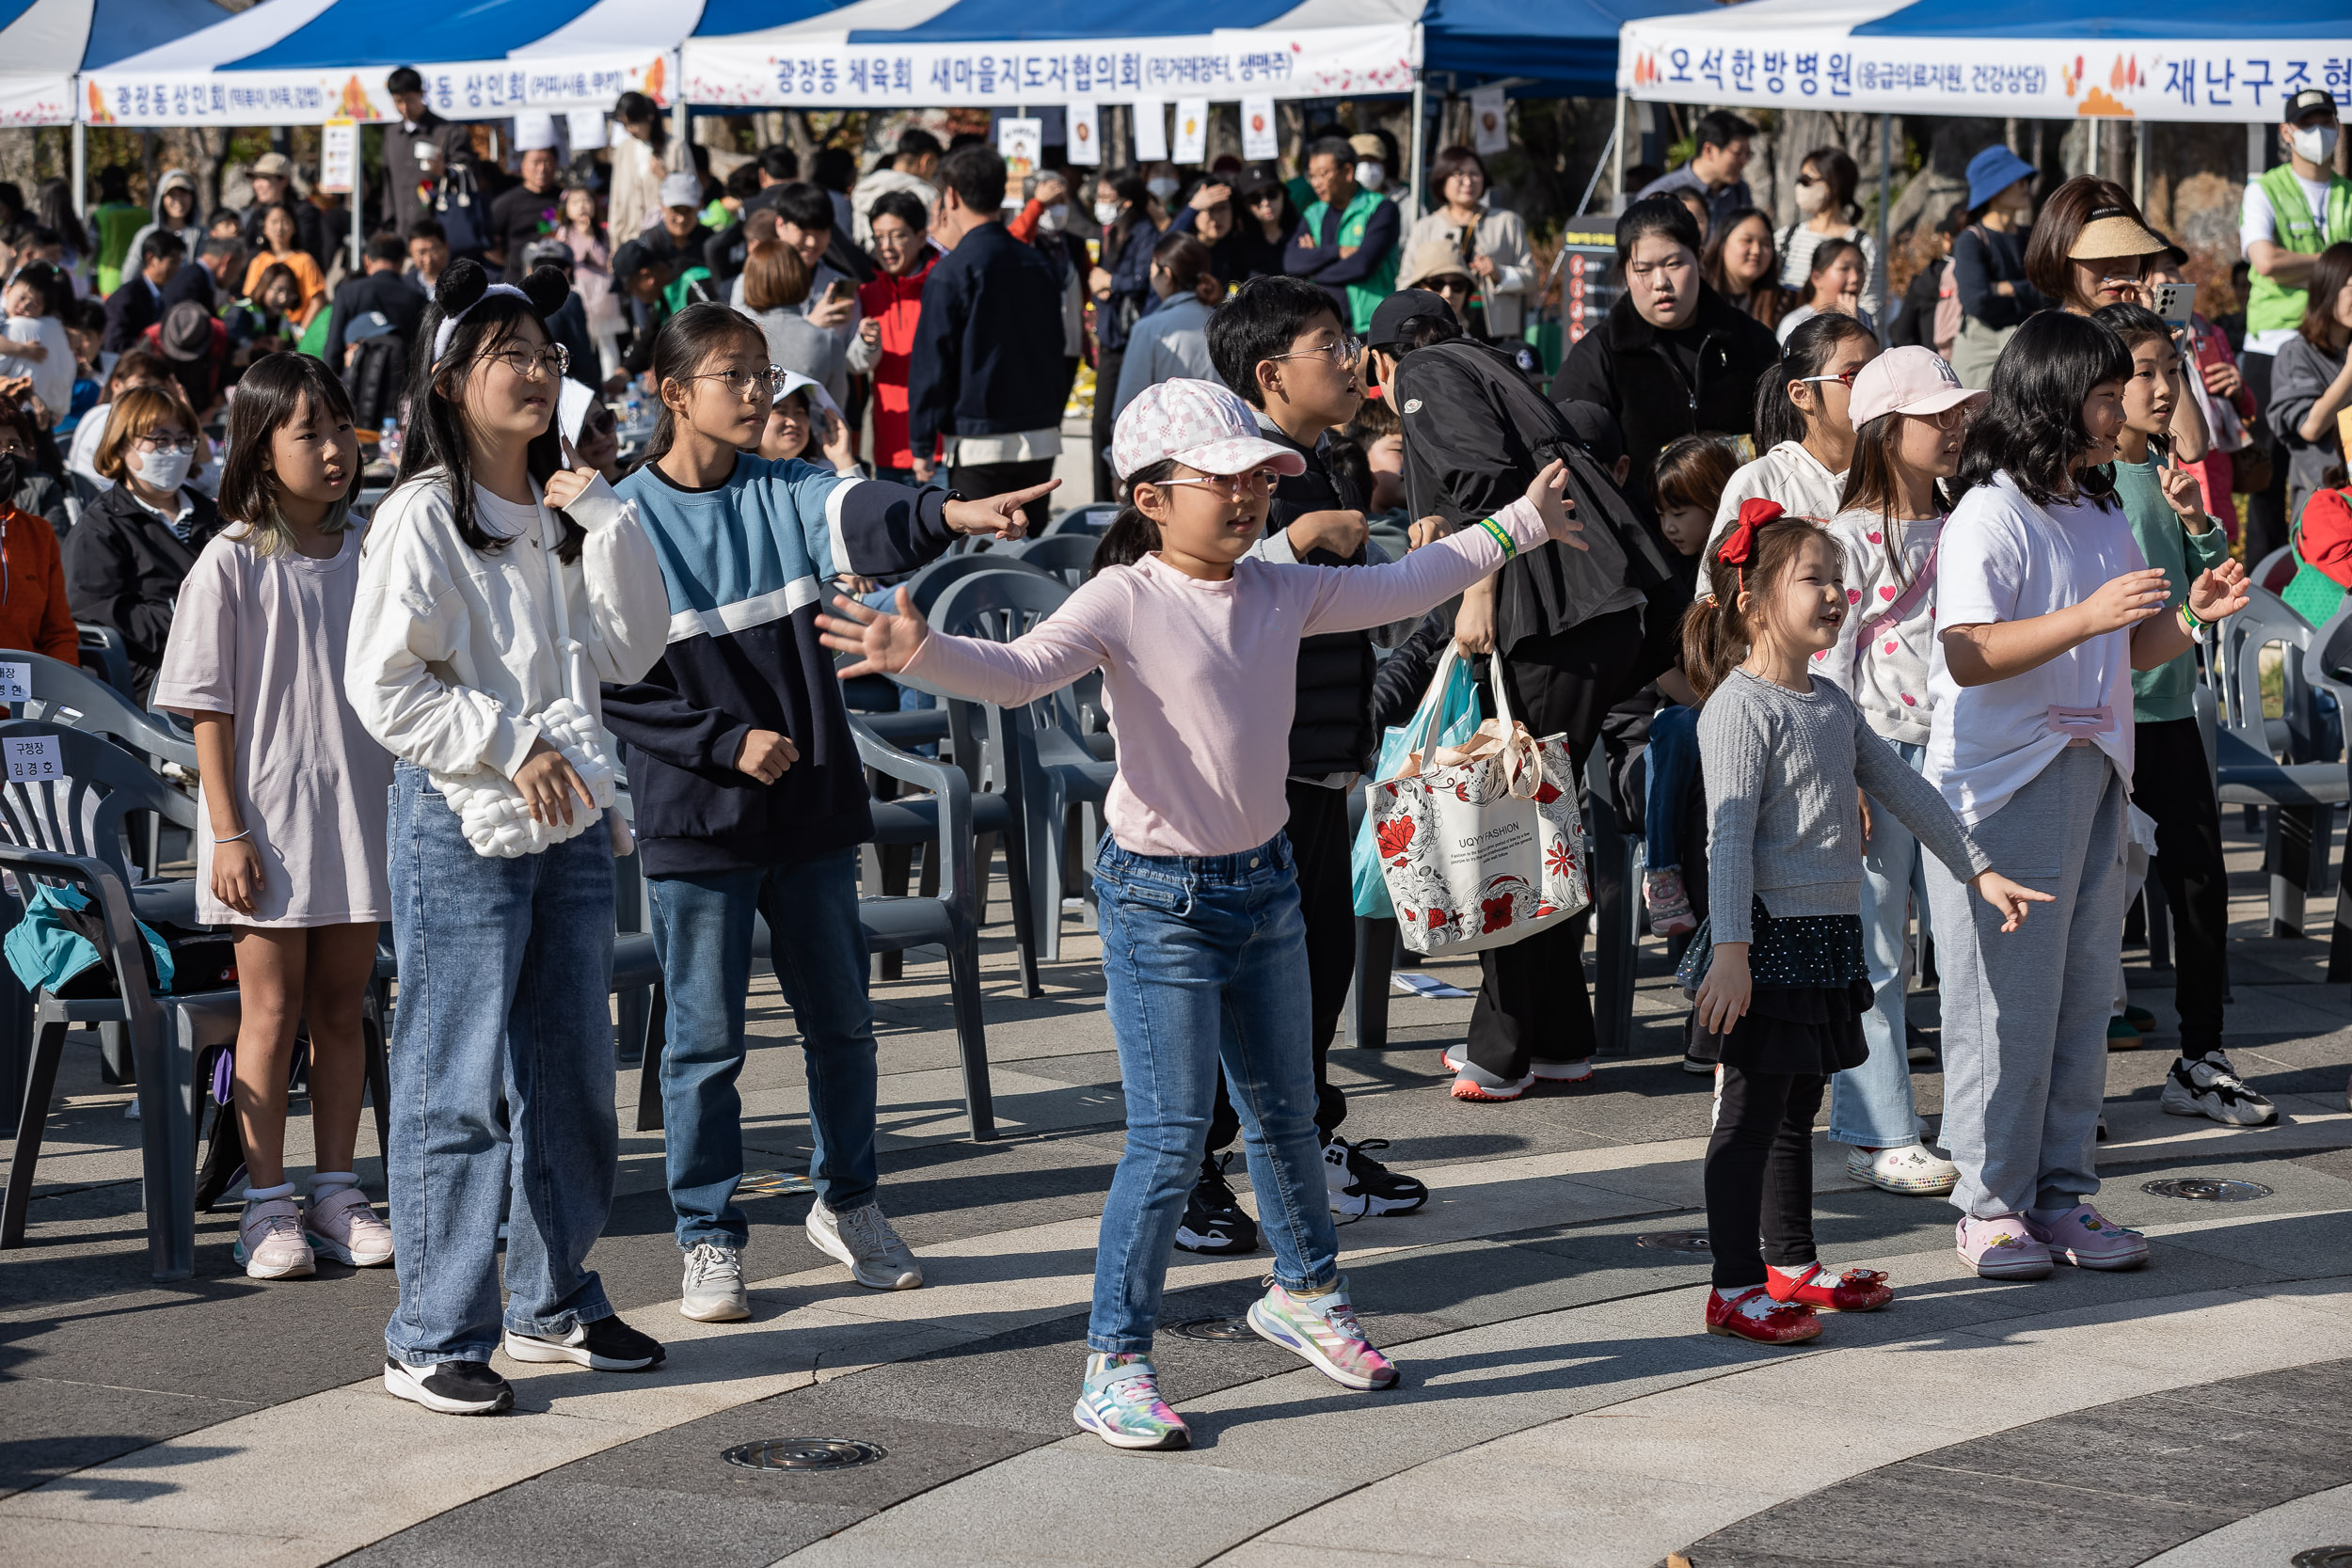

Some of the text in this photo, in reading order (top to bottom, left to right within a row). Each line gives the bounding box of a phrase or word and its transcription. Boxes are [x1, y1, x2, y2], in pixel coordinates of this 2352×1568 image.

[465, 71, 527, 107] 상인회
[777, 57, 838, 94] 광장동
[849, 56, 912, 93] 체육회
[930, 54, 1141, 93] 새마을지도자협의회
[1238, 52, 1294, 81] 생맥주)
[1669, 48, 1851, 97] 오석한방병원
[1972, 64, 2046, 94] 건강상담)
[118, 84, 167, 116] 광장동
[174, 83, 226, 115] 상인회
[16, 742, 44, 755] 구청장
